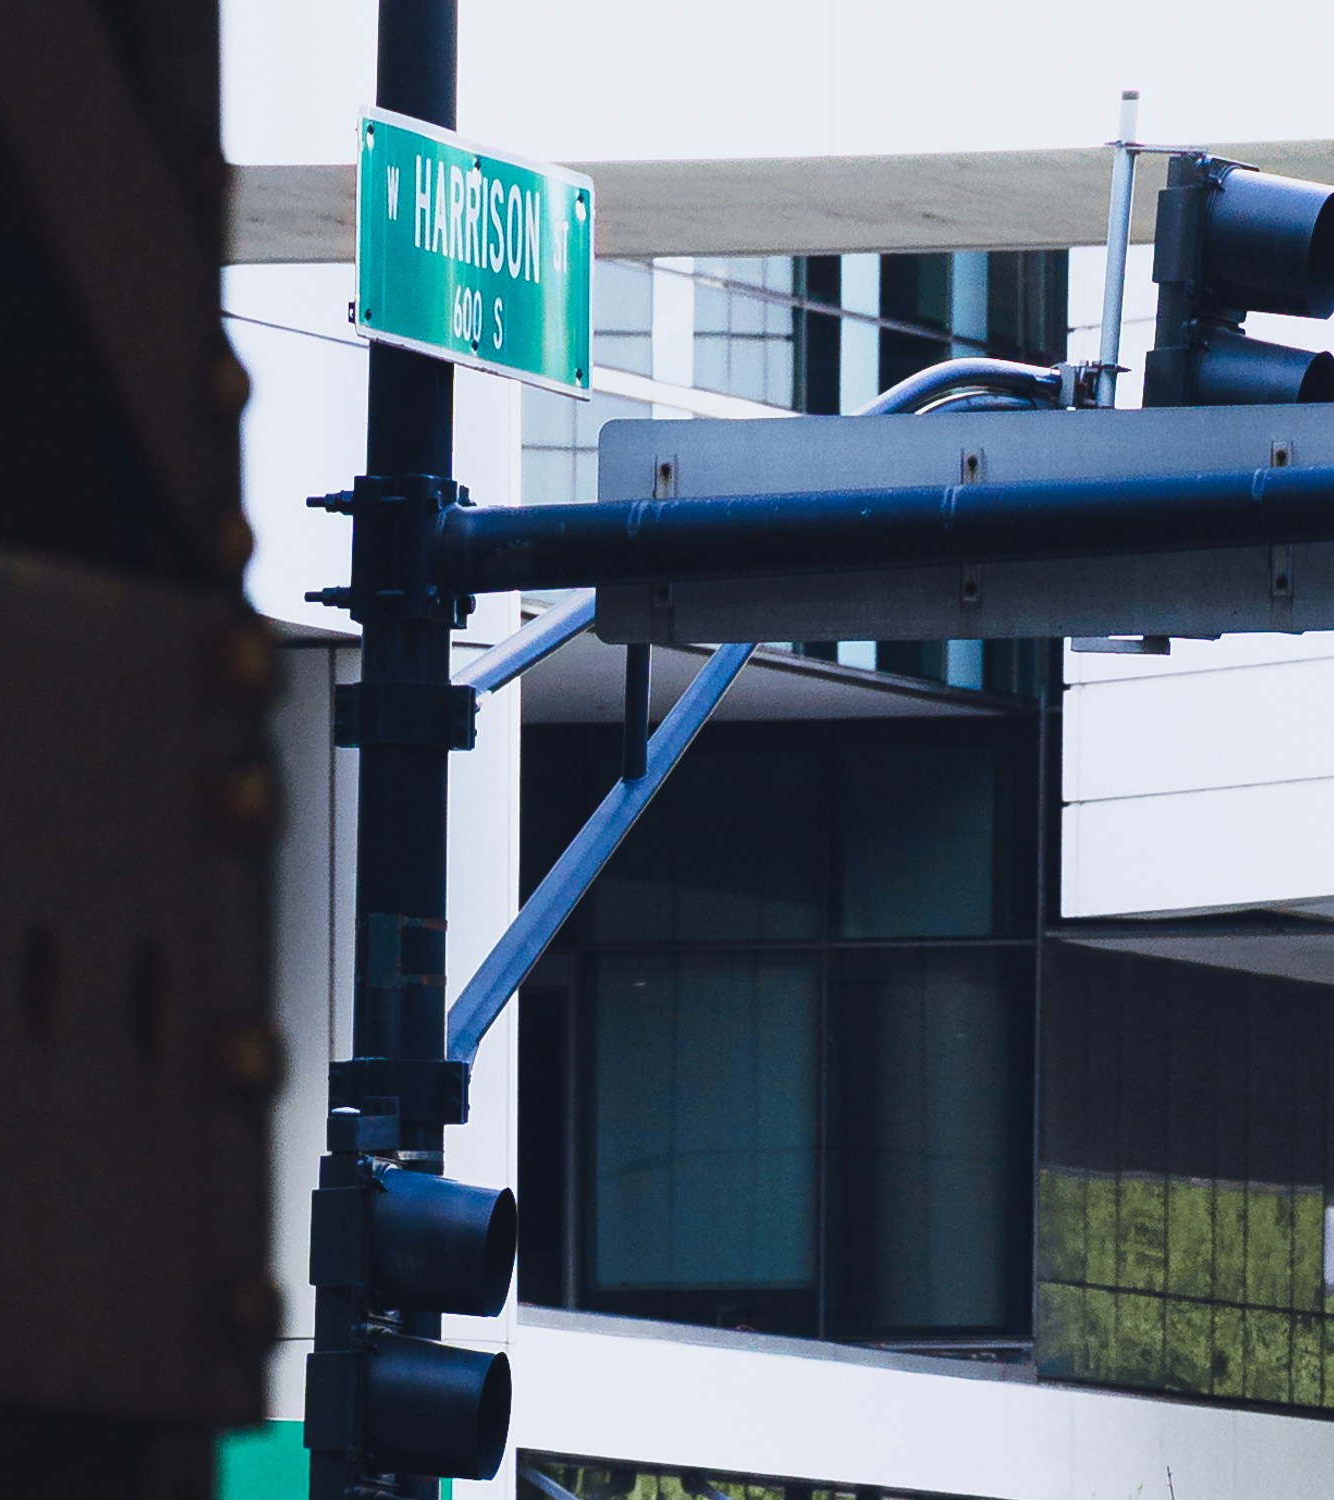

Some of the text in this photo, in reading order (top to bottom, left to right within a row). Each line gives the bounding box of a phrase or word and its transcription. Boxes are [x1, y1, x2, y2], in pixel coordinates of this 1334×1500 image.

[386, 165, 400, 221] W
[414, 153, 541, 284] HARRISON
[452, 284, 503, 350] 600 S
